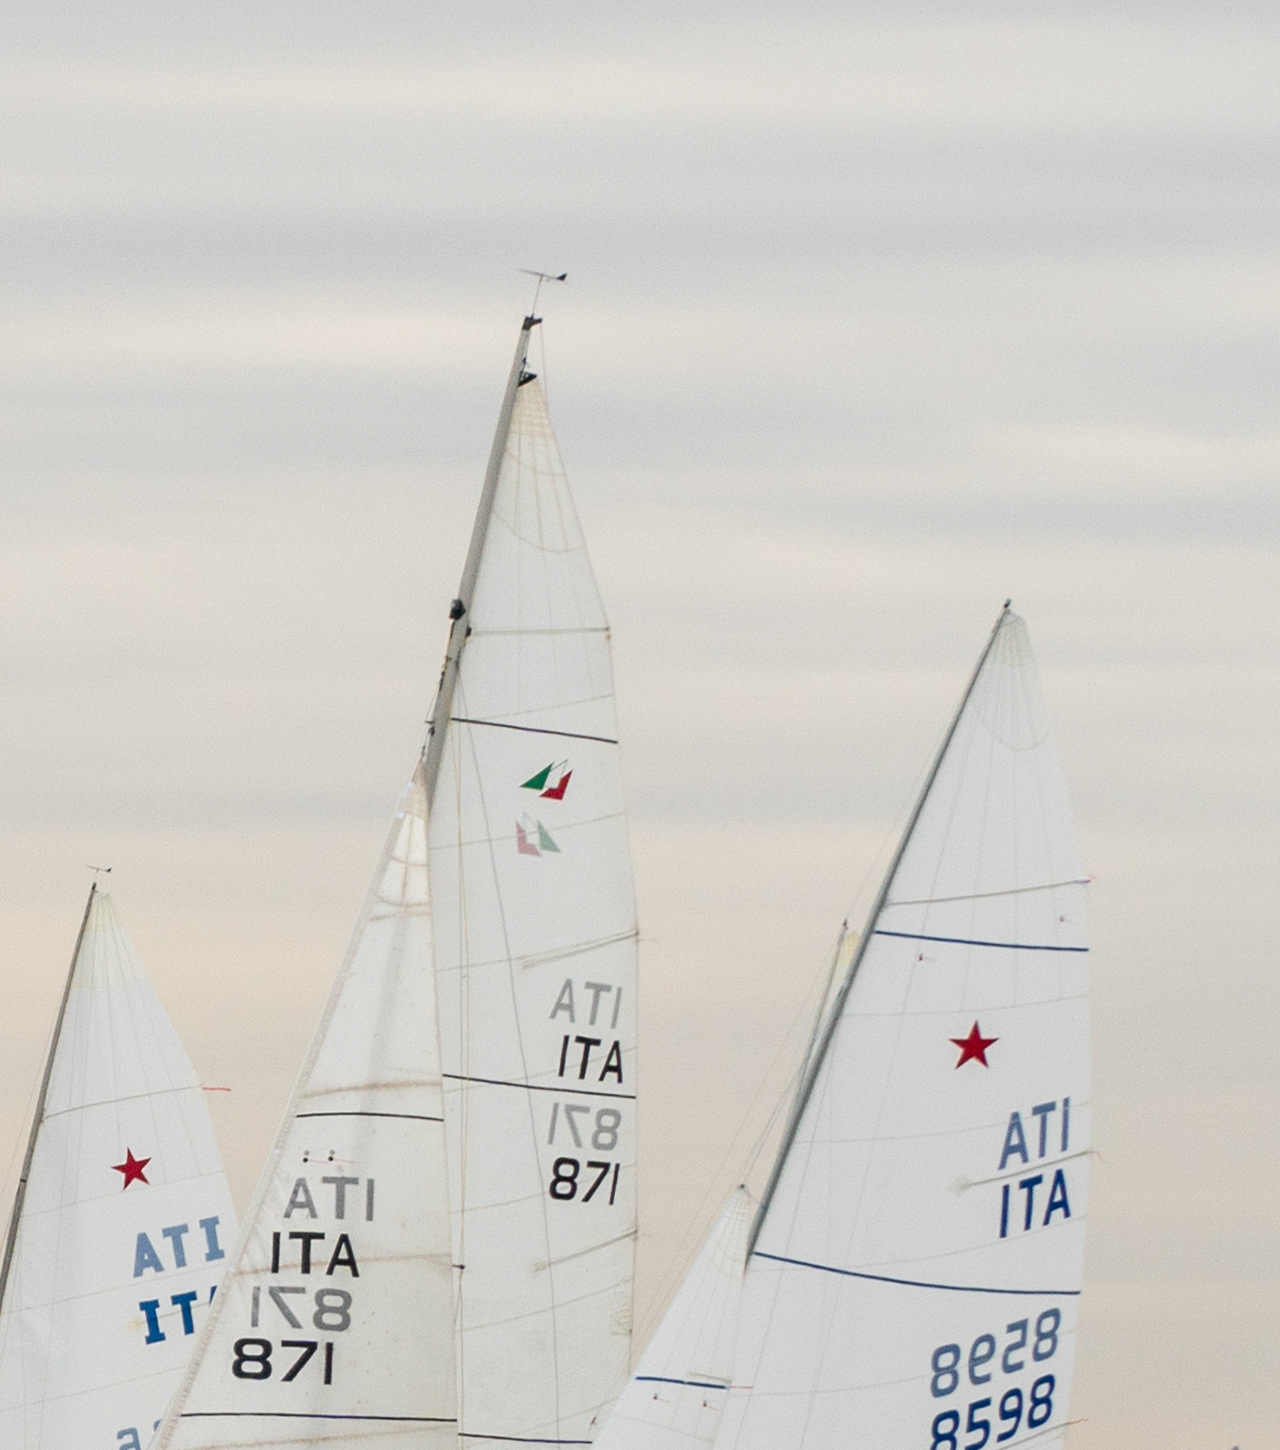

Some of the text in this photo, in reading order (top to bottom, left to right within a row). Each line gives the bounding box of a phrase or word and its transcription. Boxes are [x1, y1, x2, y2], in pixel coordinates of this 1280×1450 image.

[557, 1034, 624, 1084] ITA
[548, 1156, 621, 1206] 871
[999, 1168, 1072, 1239] ITA
[270, 1231, 360, 1278] ITA
[138, 1285, 218, 1346] IT
[231, 1337, 335, 1386] 871
